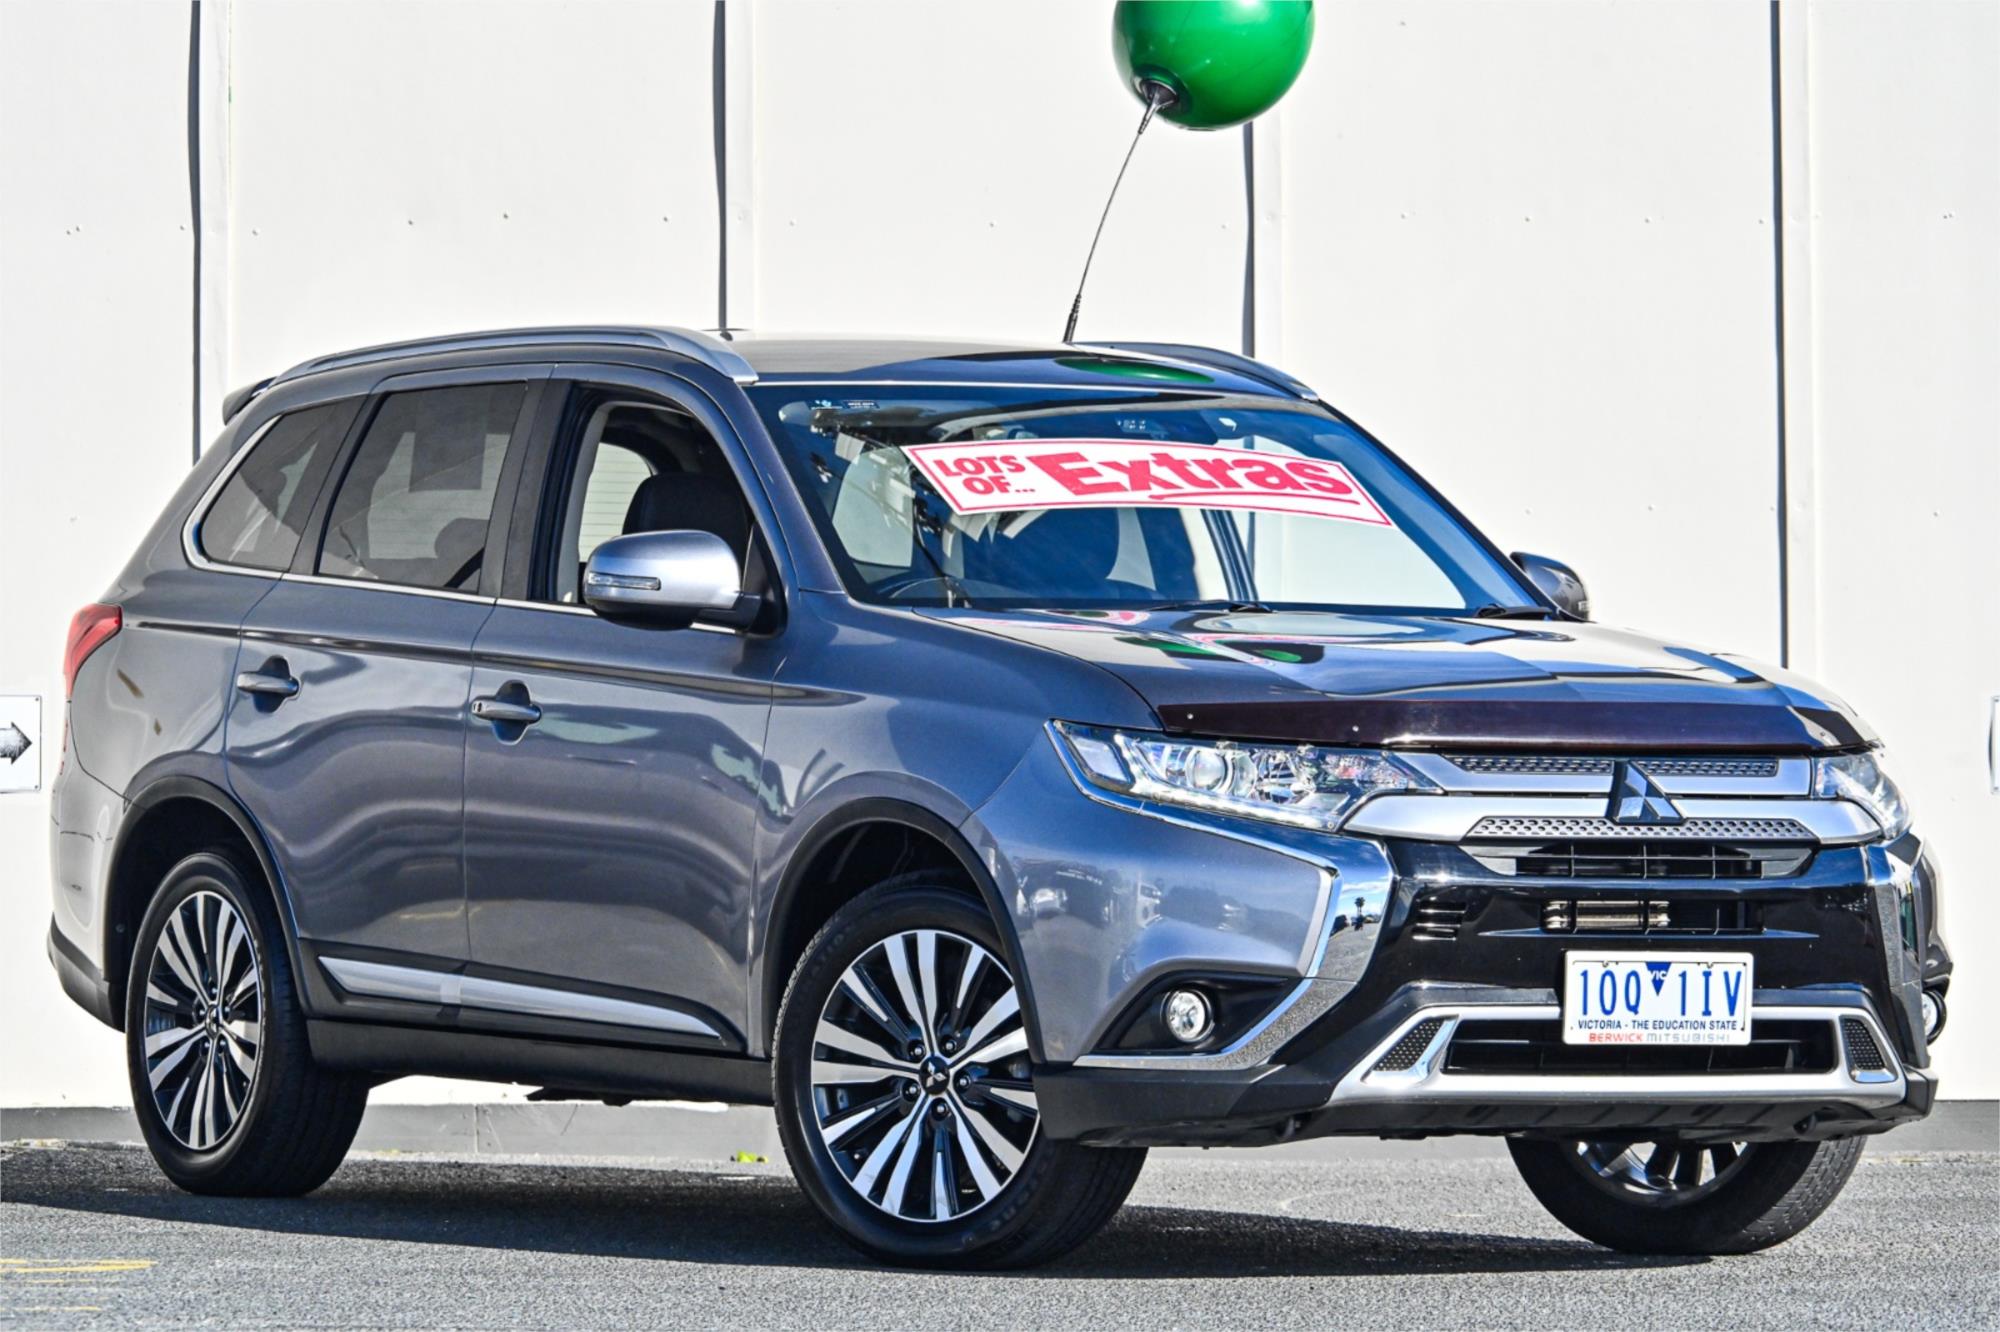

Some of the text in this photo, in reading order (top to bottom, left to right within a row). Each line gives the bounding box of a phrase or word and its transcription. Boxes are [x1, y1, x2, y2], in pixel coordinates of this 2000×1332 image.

[933, 454, 1026, 477] LOTS
[1025, 451, 1354, 497] Extras
[962, 475, 1036, 495] OF...
[1650, 970, 1667, 980] VIC
[1578, 1019, 1622, 1030] VICTORIA
[1631, 1020, 1649, 1030] THE
[1652, 1020, 1706, 1030] EDUCATION
[1709, 1020, 1737, 1030] STATE
[1588, 1032, 1730, 1043] BERWICK MITSUBISHI
